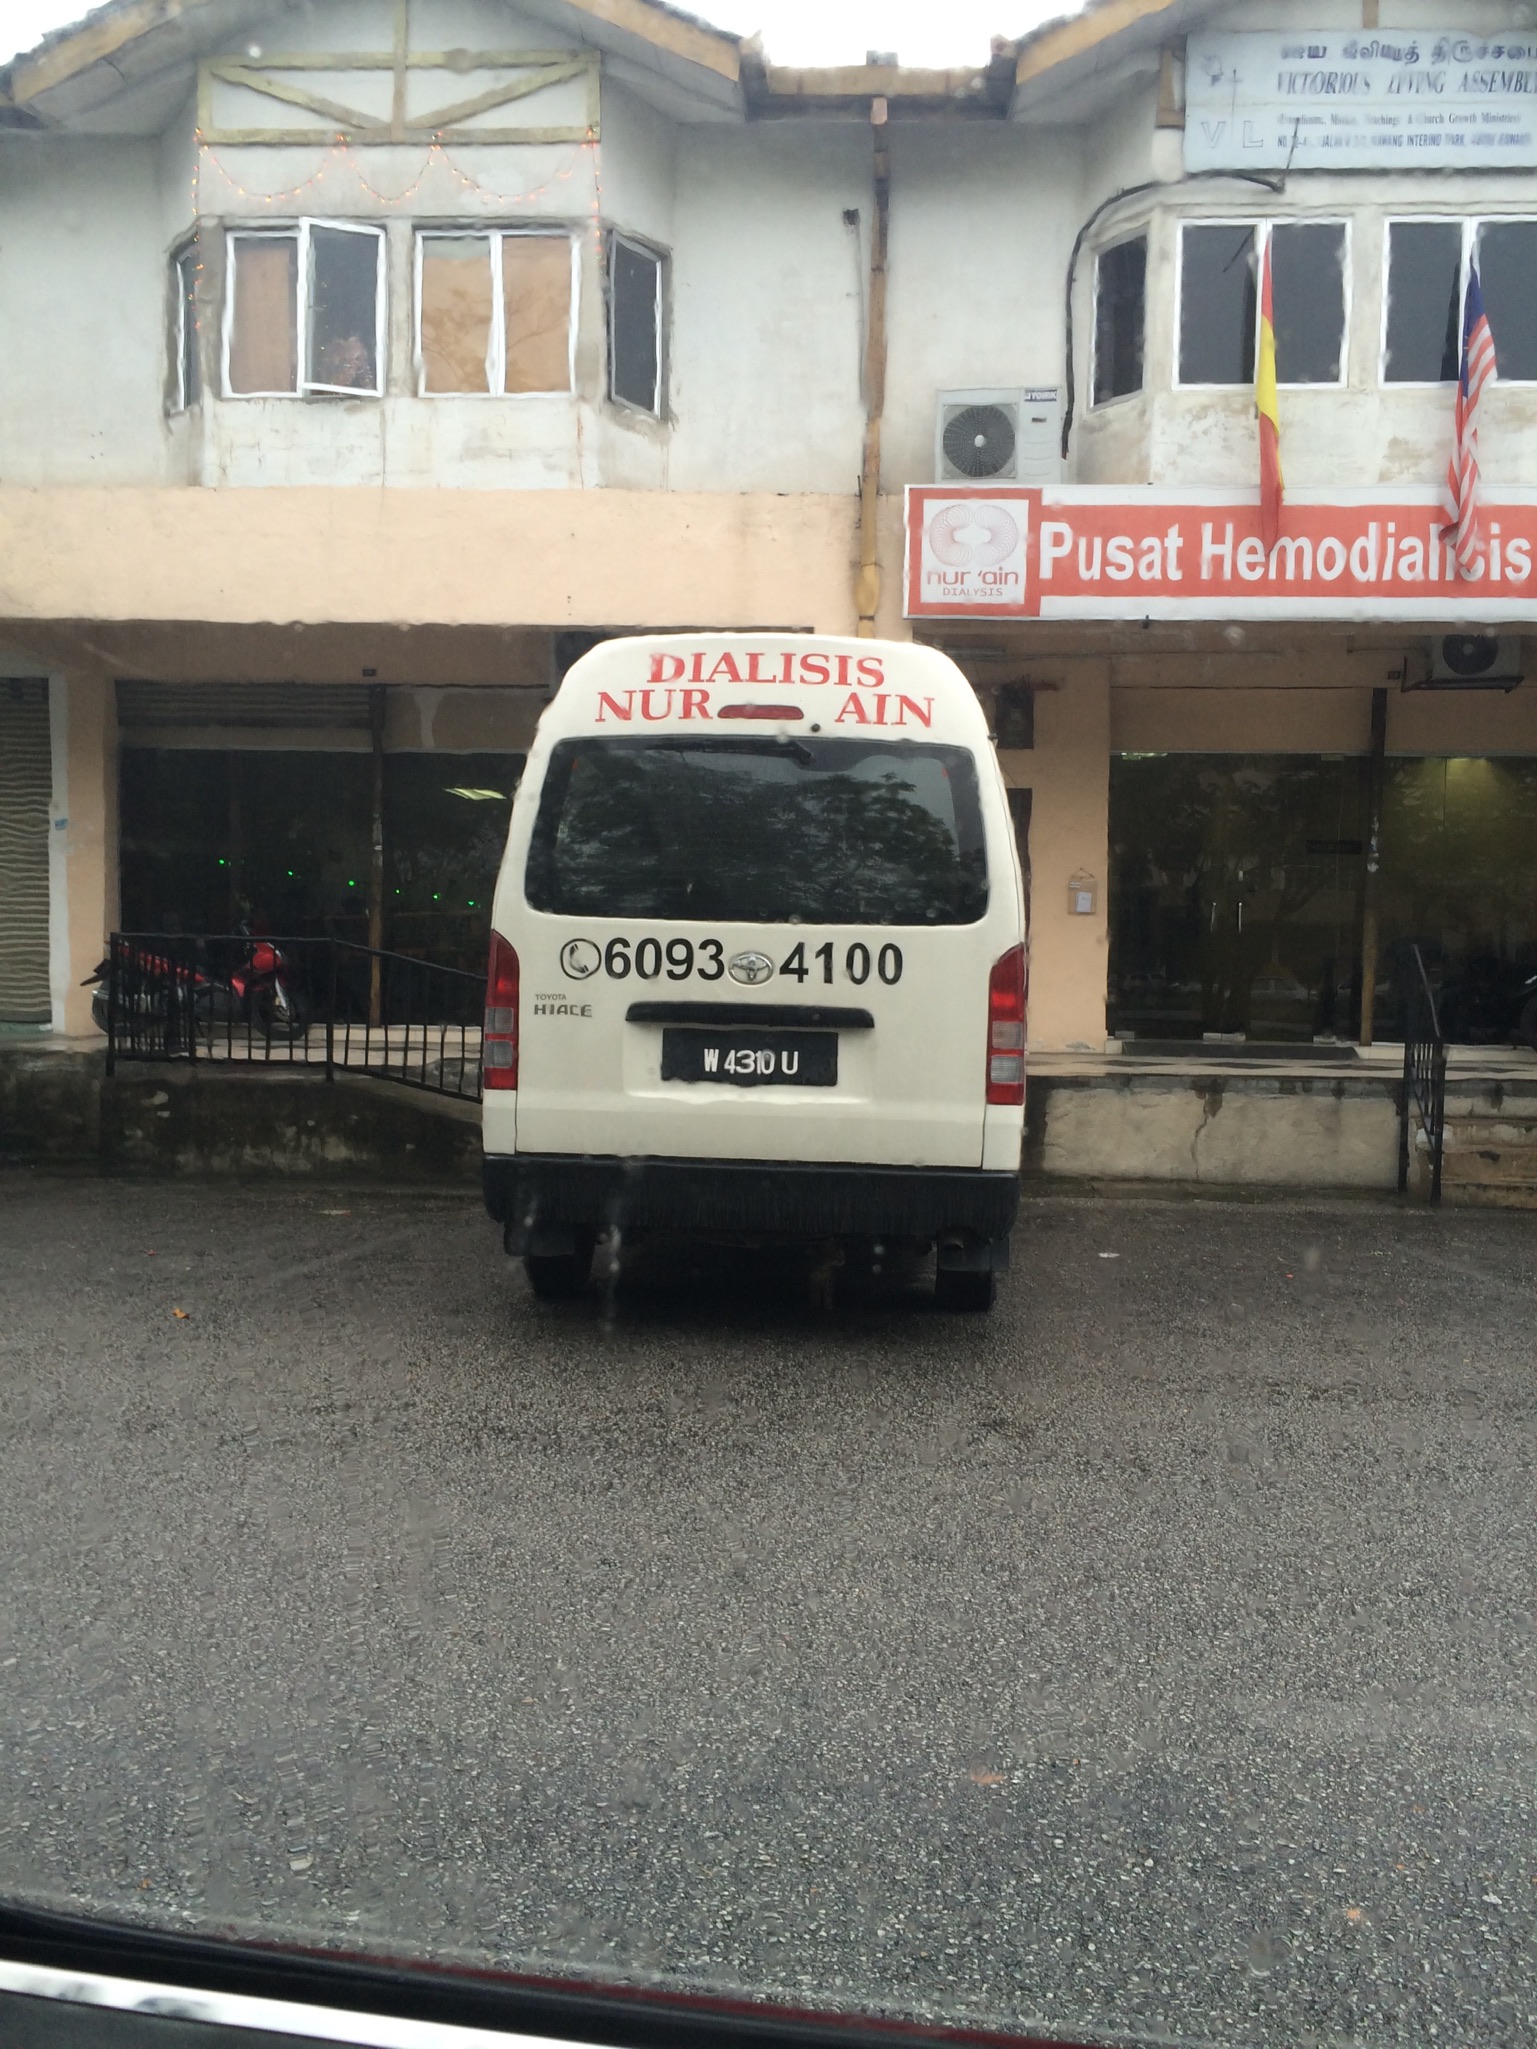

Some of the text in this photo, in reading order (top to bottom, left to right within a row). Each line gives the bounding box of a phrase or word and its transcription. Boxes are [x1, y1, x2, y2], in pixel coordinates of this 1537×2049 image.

[1277, 71, 1371, 95] VICTORIOUS
[1039, 521, 1183, 580] Pusat
[927, 570, 971, 585] nur
[943, 587, 1003, 596] DIALYSIS
[647, 651, 885, 688] DIALISIS
[595, 689, 935, 728] NUR AIN
[604, 937, 903, 985] 6093 4100
[534, 1004, 592, 1017] HIACE
[704, 1048, 719, 1072] W
[781, 1051, 799, 1074] U
